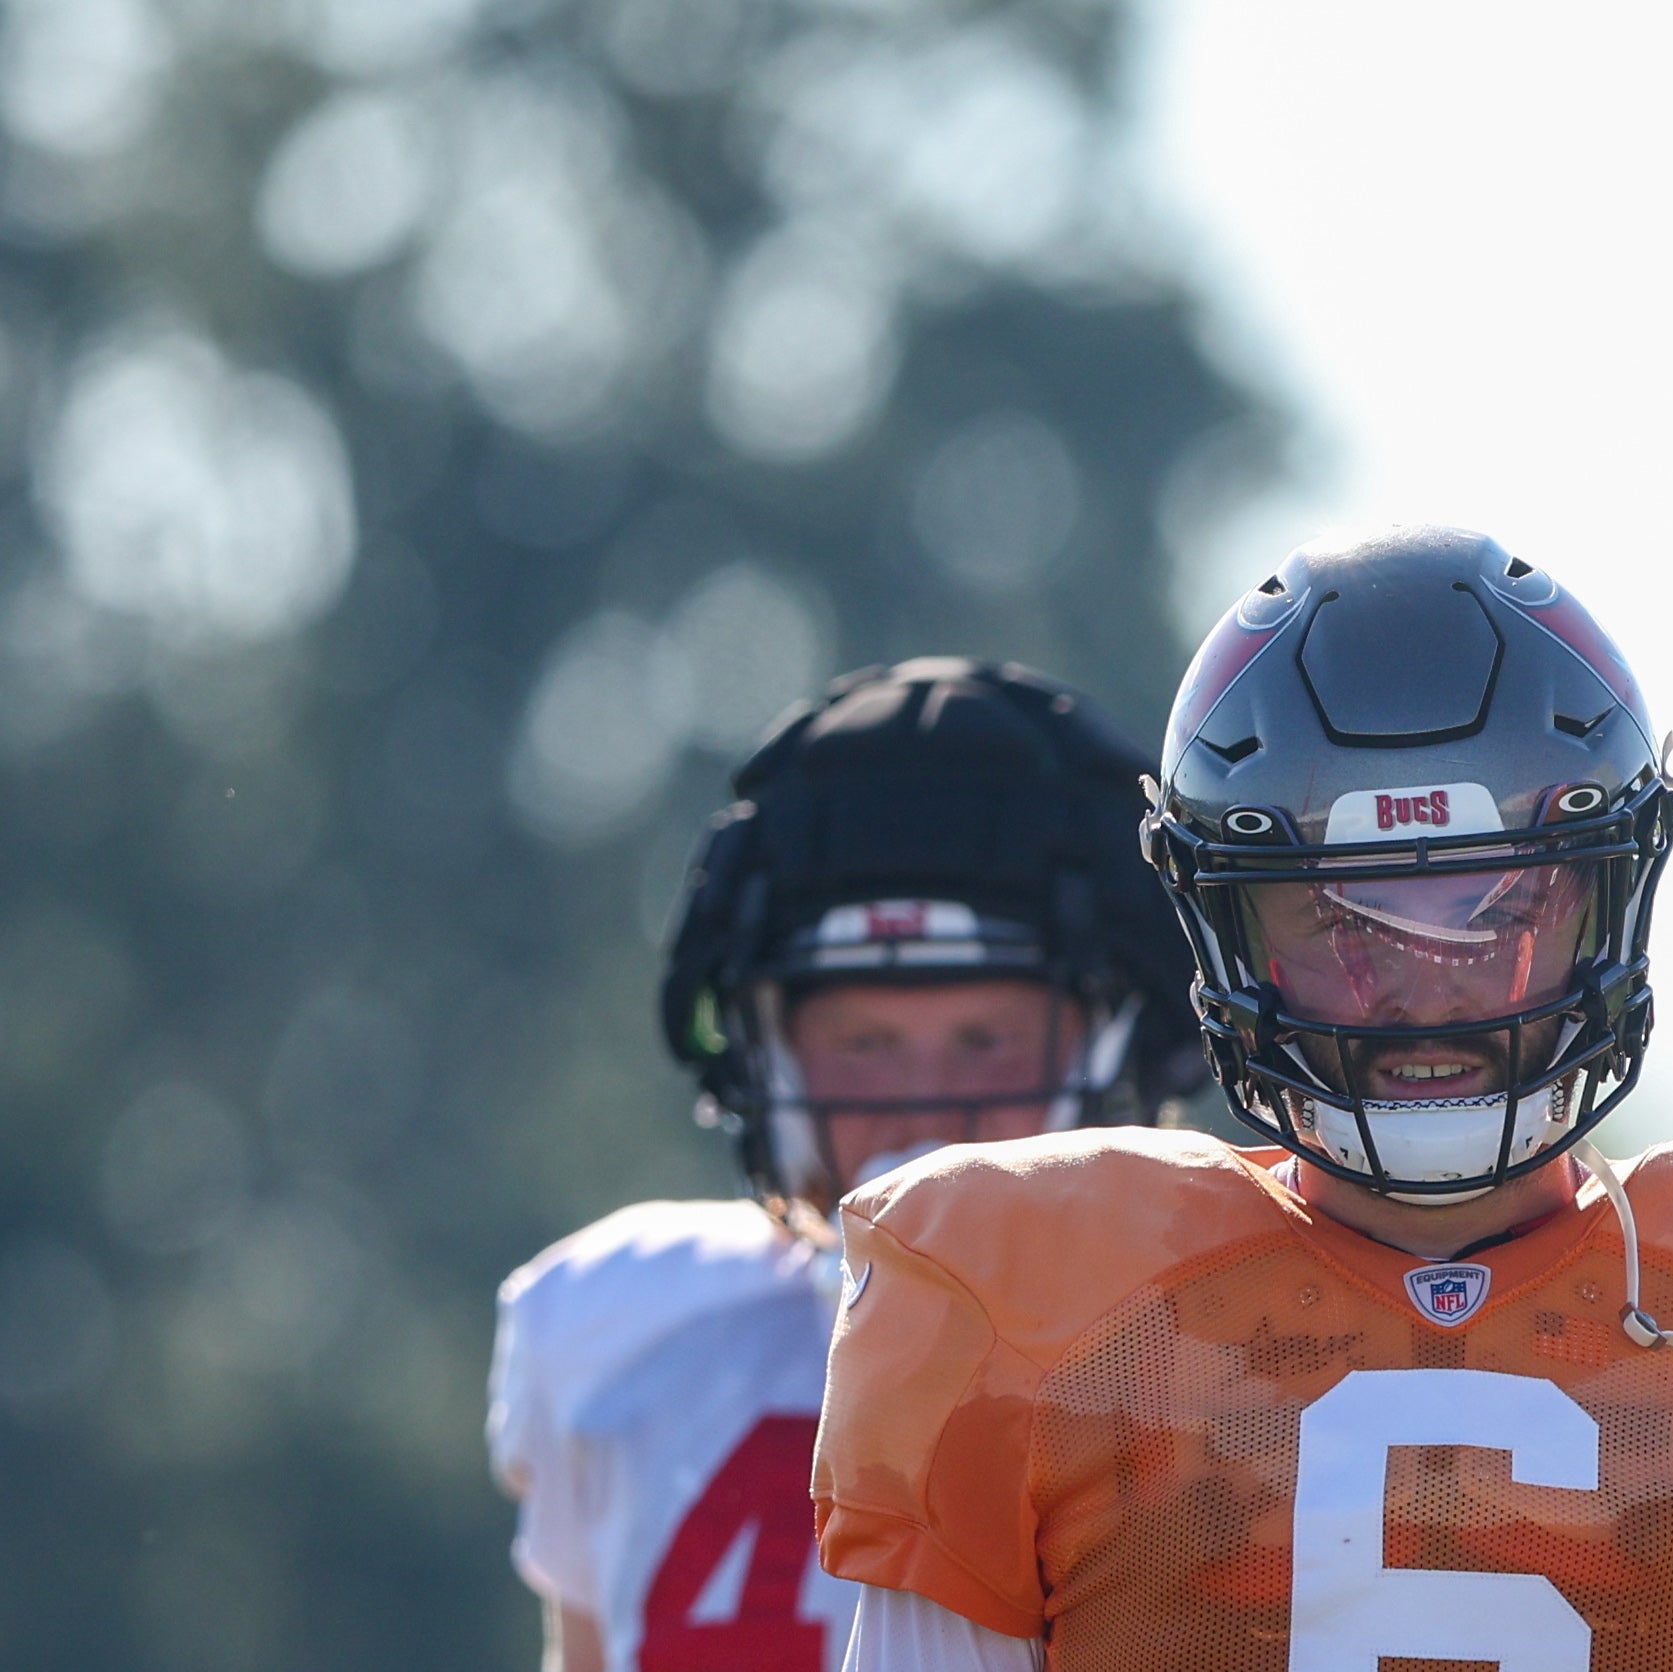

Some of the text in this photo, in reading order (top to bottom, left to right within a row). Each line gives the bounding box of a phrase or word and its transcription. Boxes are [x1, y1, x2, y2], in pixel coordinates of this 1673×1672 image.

[1374, 789, 1451, 832] BUCS
[1416, 1269, 1481, 1285] EQUIPMENT
[1435, 1293, 1465, 1312] NFL
